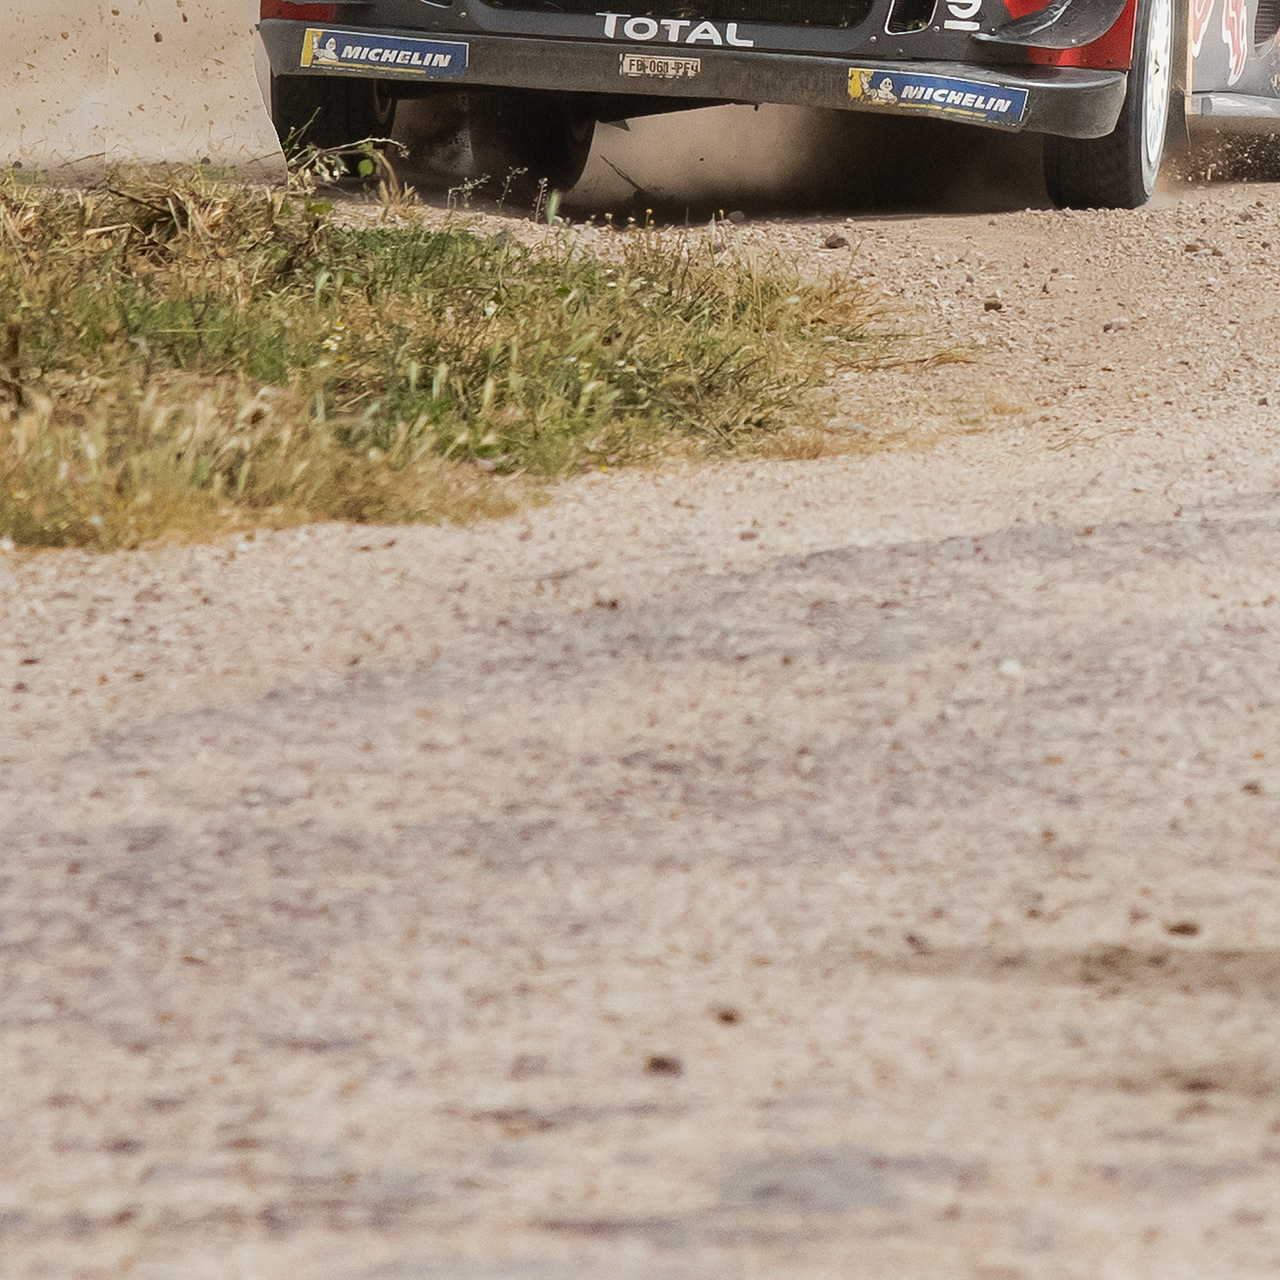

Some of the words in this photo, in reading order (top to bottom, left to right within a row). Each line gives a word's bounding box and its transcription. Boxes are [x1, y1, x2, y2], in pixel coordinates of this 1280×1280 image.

[595, 12, 755, 48] TOTAL
[340, 45, 452, 68] MICHELIN
[900, 85, 1013, 113] MICHELIN
